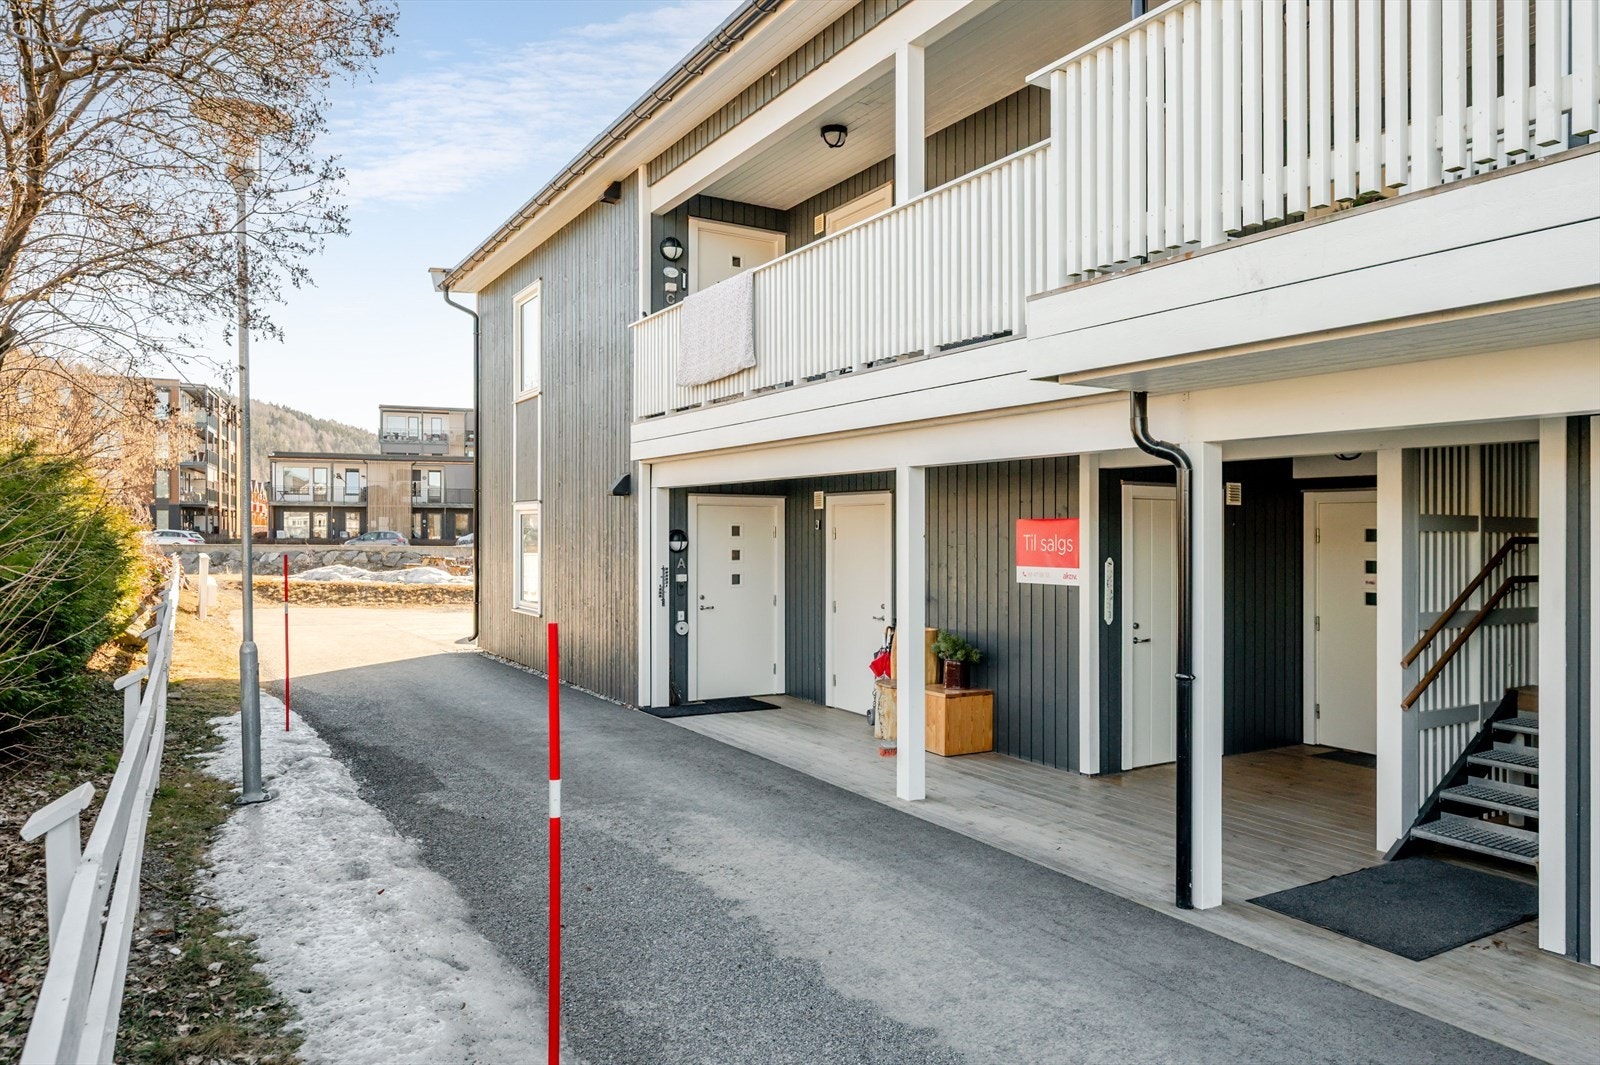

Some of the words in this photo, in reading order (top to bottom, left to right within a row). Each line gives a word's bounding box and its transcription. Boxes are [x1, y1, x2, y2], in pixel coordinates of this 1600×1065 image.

[1023, 534, 1037, 551] Til
[1040, 533, 1073, 555] salgs
[677, 558, 686, 568] A
